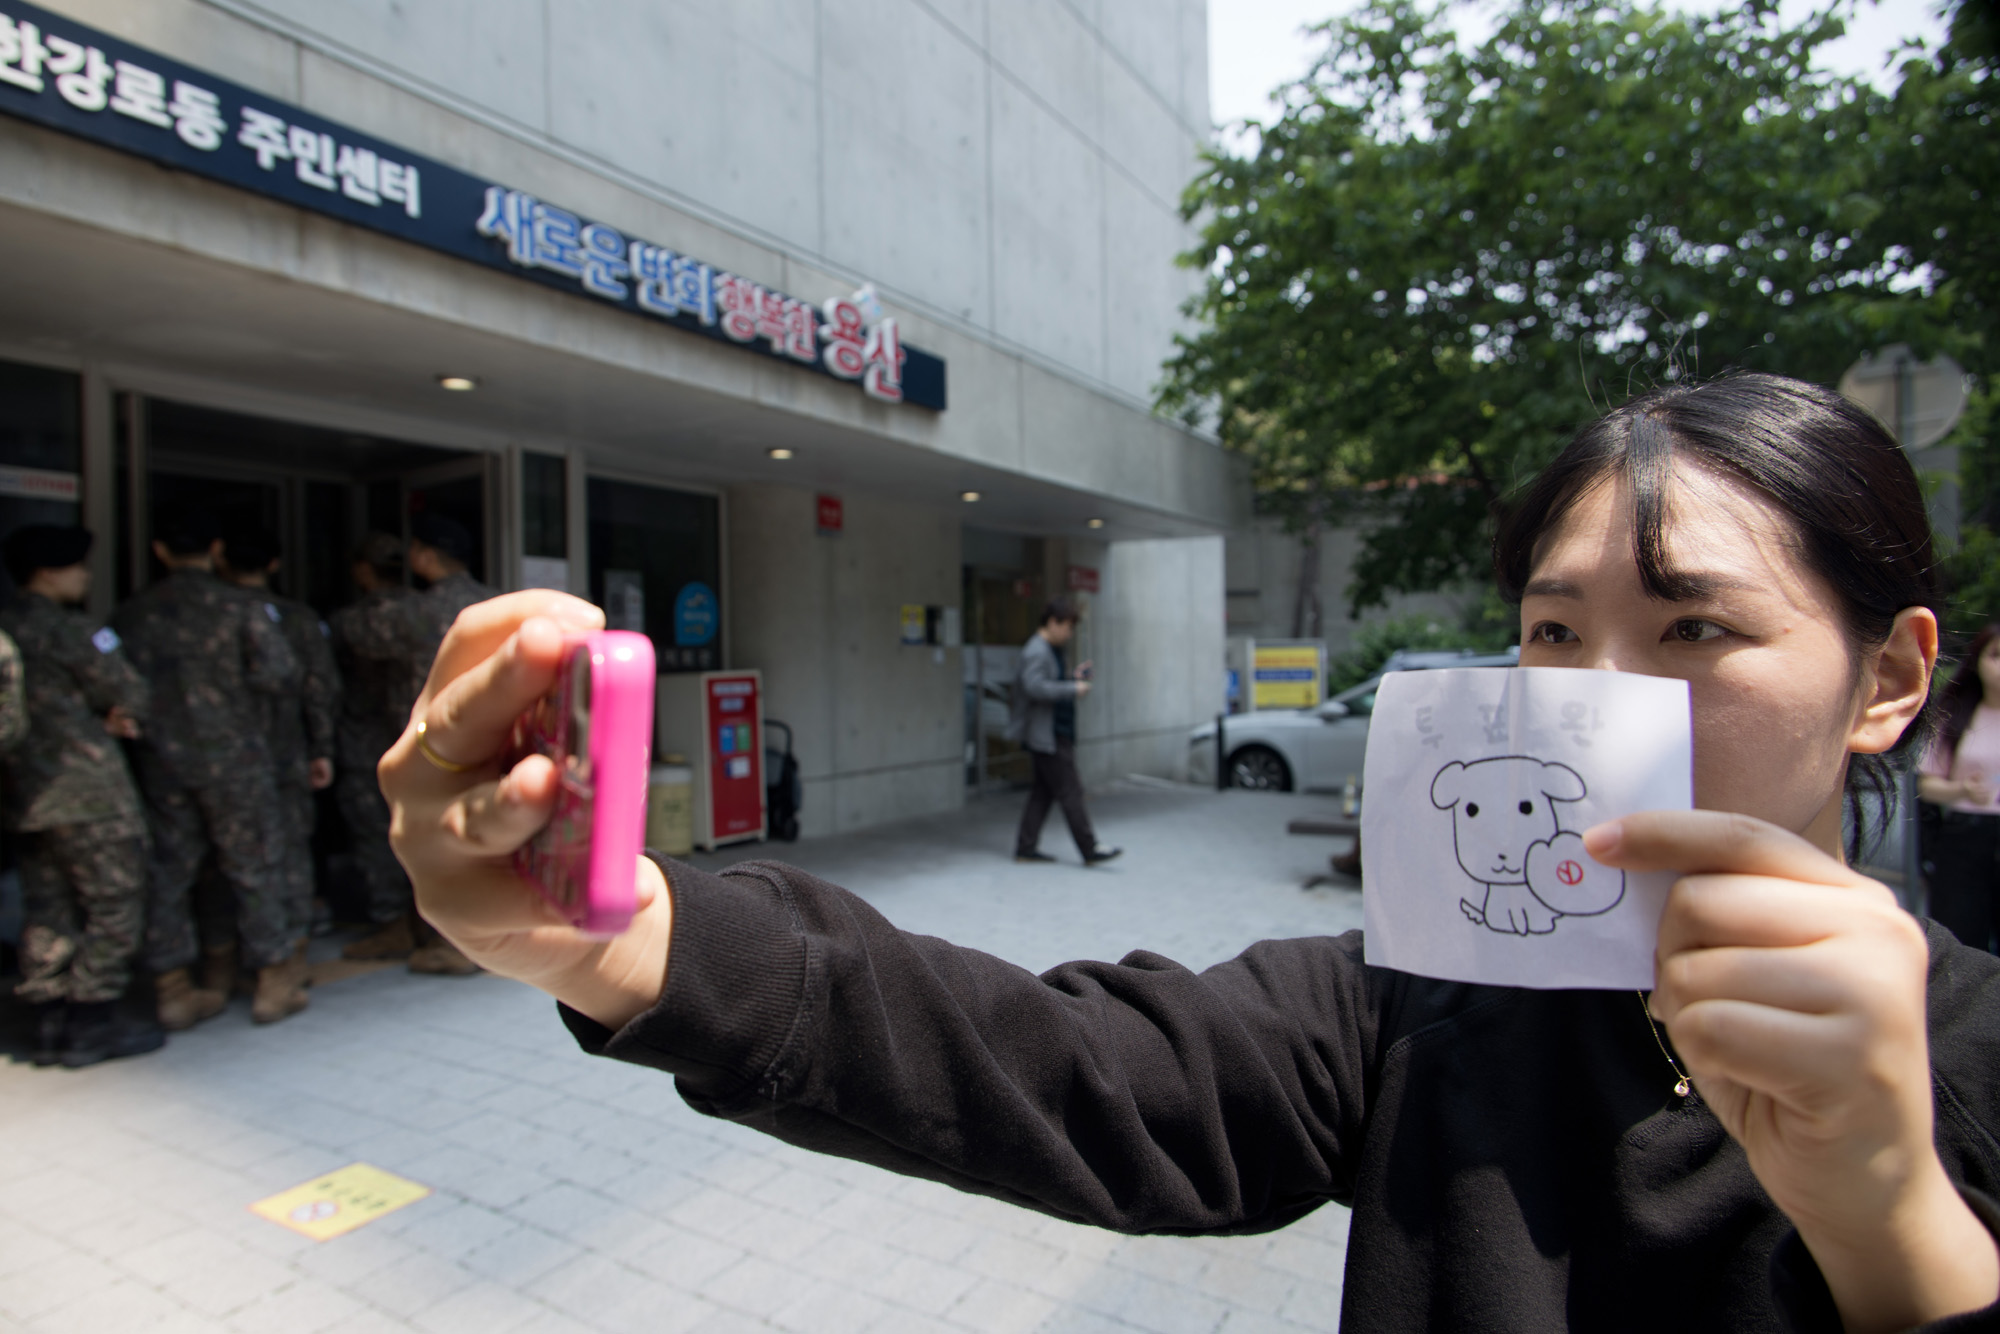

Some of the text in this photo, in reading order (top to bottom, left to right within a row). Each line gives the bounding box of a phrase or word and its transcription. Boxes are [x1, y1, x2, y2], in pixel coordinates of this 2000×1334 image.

[0, 12, 904, 401] 한강로동 주민센터 새로운 변화 행복한 용산
